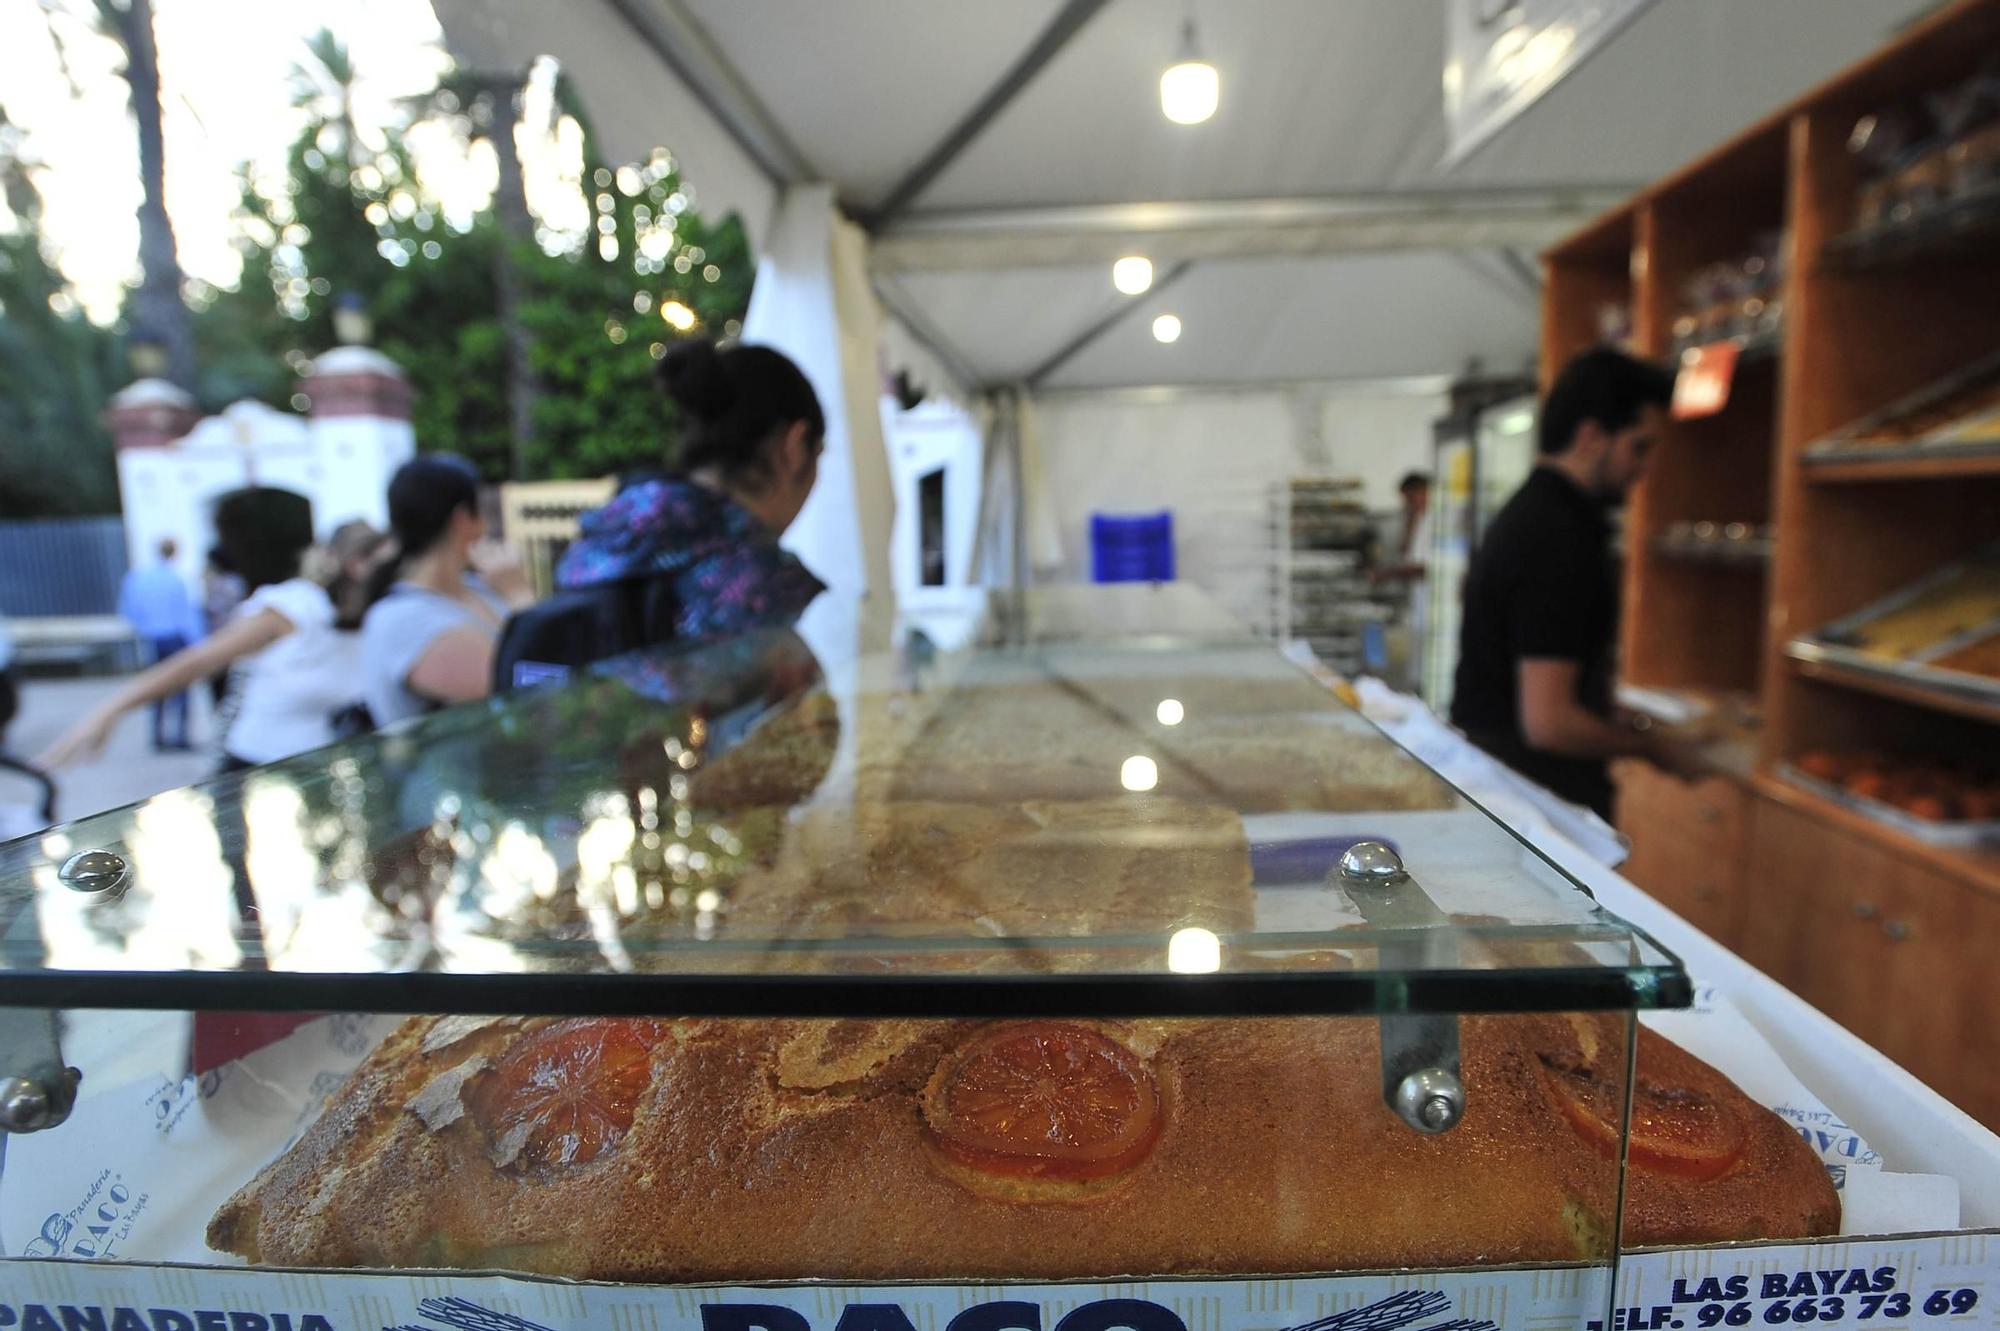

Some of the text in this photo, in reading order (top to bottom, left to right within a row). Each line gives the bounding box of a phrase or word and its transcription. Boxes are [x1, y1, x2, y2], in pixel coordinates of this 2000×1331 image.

[73, 1184, 129, 1258] PACO
[1672, 1266, 1897, 1304] LAS BAYAS
[1697, 1302, 1753, 1329] 96
[1763, 1297, 1845, 1325] 663
[1857, 1293, 1911, 1319] 73
[1923, 1288, 1978, 1317] 69
